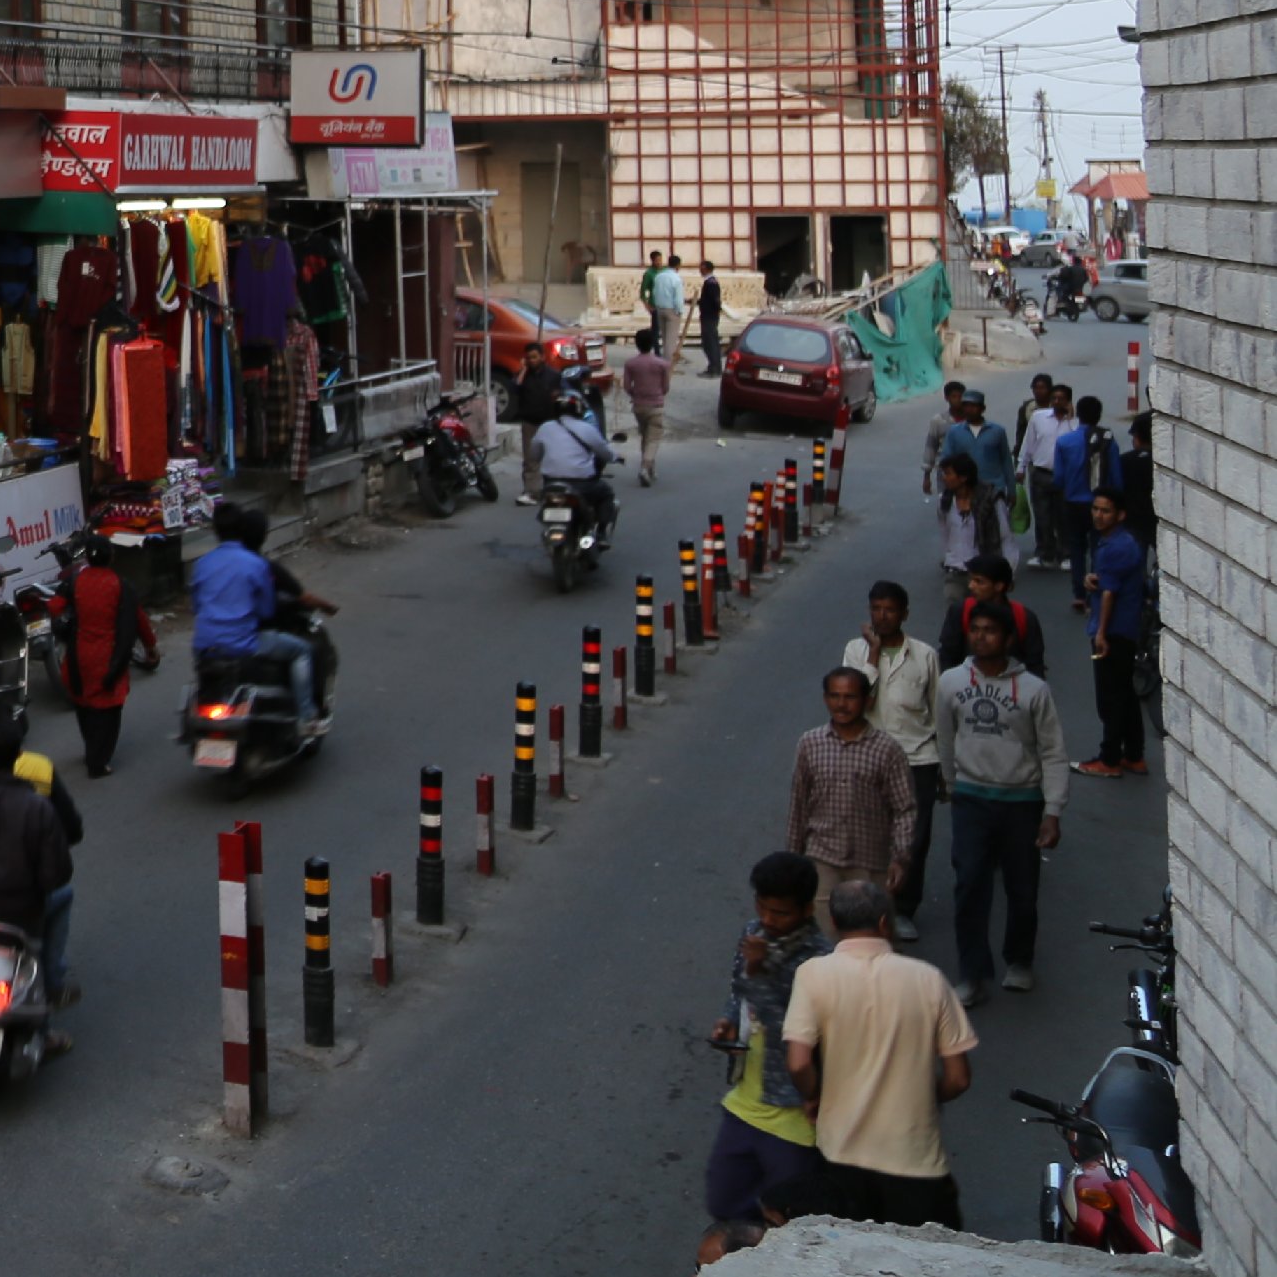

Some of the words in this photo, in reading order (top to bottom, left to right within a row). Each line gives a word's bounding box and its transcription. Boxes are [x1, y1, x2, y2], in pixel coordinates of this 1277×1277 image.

[124, 133, 186, 171] GARHWAL
[190, 135, 252, 171] HANDLOOM
[7, 509, 53, 549] Amul
[53, 503, 82, 536] Milk
